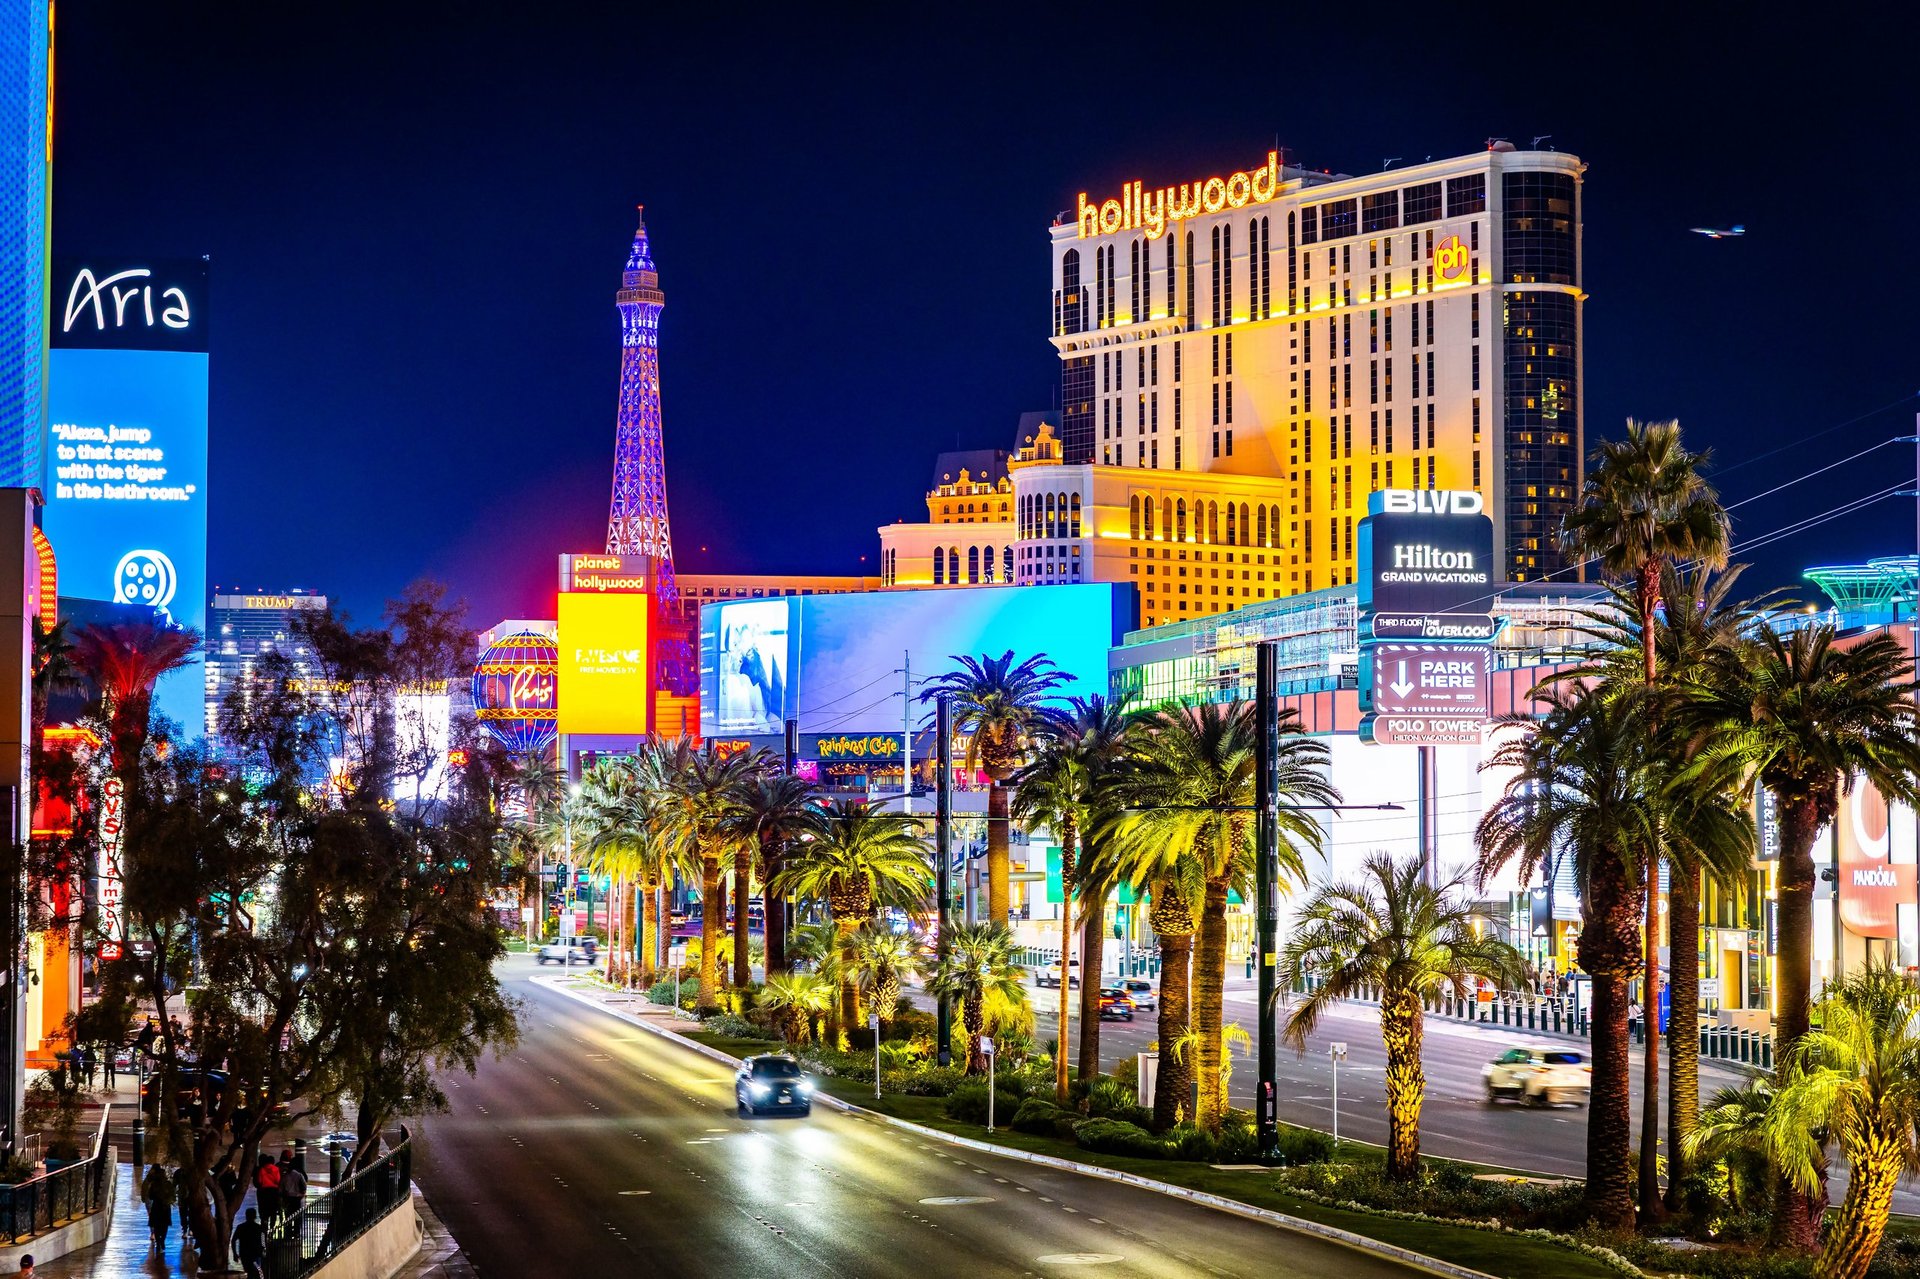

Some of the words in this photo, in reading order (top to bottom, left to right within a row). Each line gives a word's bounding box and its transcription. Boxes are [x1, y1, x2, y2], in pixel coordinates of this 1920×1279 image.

[1078, 151, 1277, 240] hollywood
[1438, 235, 1468, 278] ph
[63, 268, 190, 332] Aria
[108, 424, 151, 444] jump
[57, 444, 76, 460] to
[77, 444, 113, 460] that
[114, 447, 163, 461] scene
[57, 463, 94, 479] with
[95, 464, 124, 480] the
[125, 464, 167, 483] tiger
[56, 482, 73, 499] in
[74, 483, 102, 499] the
[1384, 489, 1483, 514] BLVD
[574, 556, 621, 571] planet
[1394, 545, 1474, 569] Hilton
[574, 575, 644, 591] hollywood
[1381, 572, 1423, 582] GRAND
[1424, 573, 1488, 583] VACATIONS
[246, 597, 295, 609] TRUMP
[1378, 618, 1398, 627] THIRD
[1399, 618, 1423, 627] FLOOR
[1426, 625, 1490, 637] OVERLOOK
[1421, 661, 1475, 674] PARK
[511, 665, 554, 714] Paris
[1421, 675, 1476, 688] HERE
[1388, 720, 1424, 732] POLO
[1429, 720, 1481, 733] TOWERS
[818, 736, 868, 757] Rainforest
[869, 736, 898, 757] Cafe
[1421, 734, 1456, 742] VACATION
[103, 780, 121, 835] CVS
